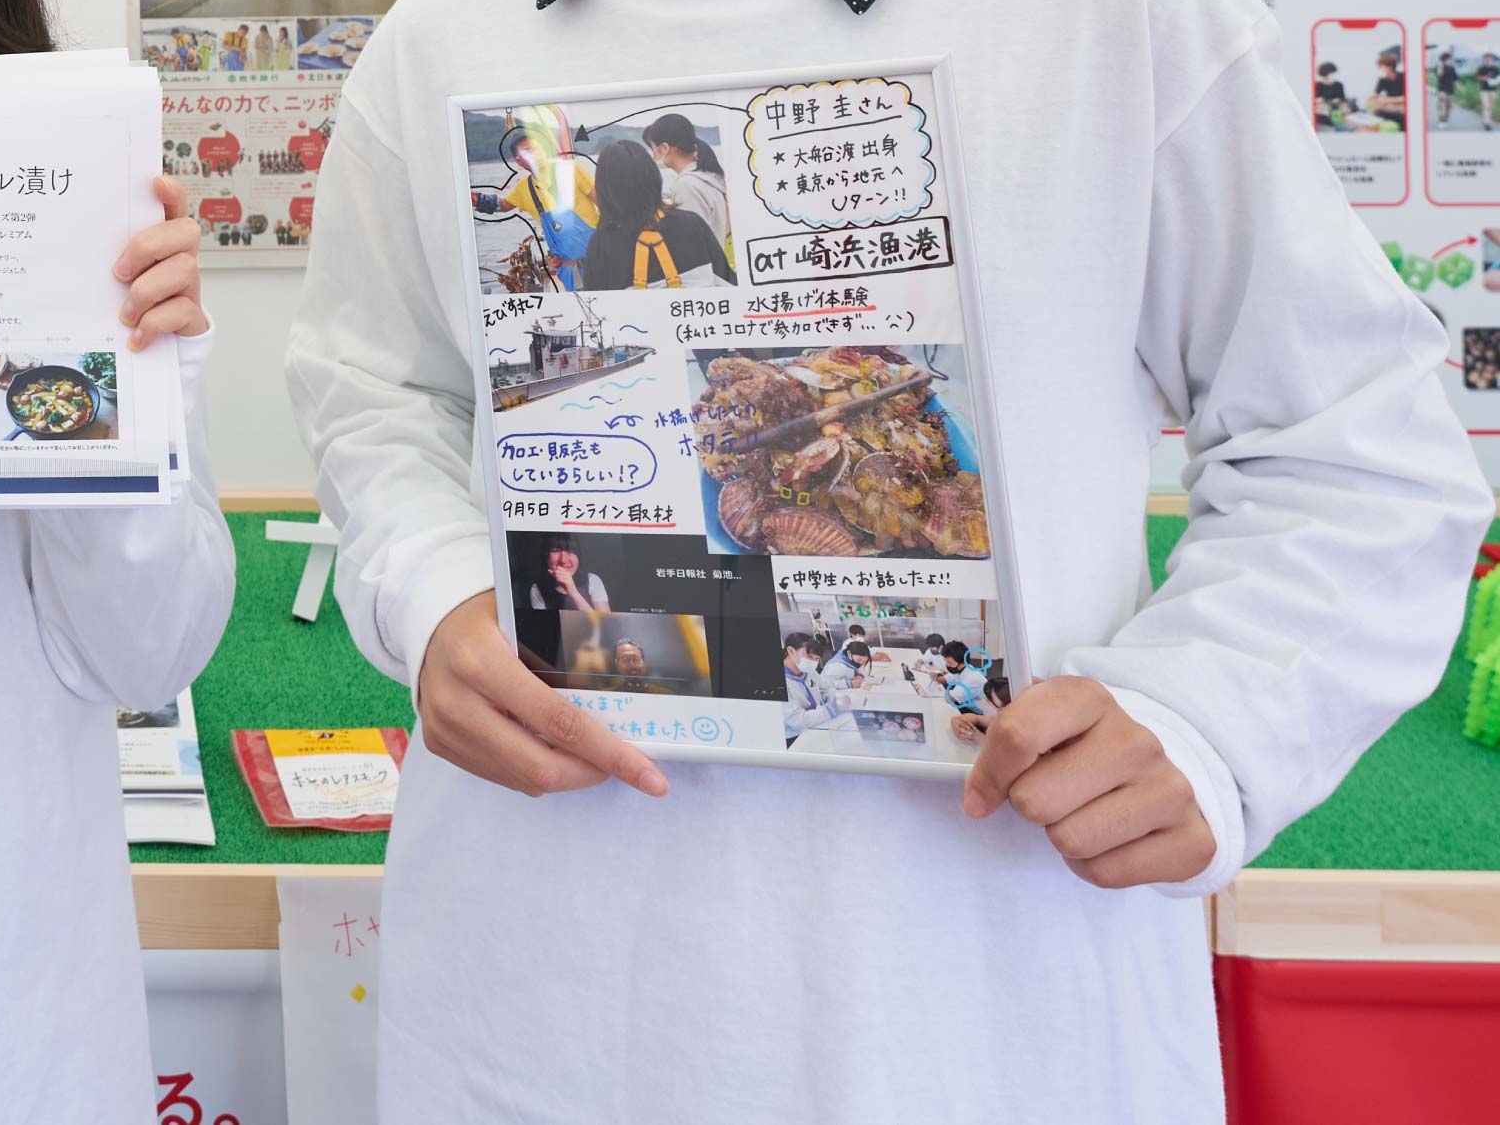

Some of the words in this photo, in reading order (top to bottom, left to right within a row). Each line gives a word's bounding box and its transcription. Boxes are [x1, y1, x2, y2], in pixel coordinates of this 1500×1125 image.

[162, 93, 344, 114] みんなの力で、ニッポ
[765, 97, 821, 131] 中野
[832, 93, 894, 121] 圭さん
[793, 133, 899, 169] 大船渡出身
[796, 166, 904, 196] 東京から地元へ
[754, 247, 788, 273] at
[795, 226, 942, 271] 崎浜漁港
[669, 298, 730, 319] 8月30日
[745, 286, 870, 315] 水揚げ体験
[654, 403, 757, 428] 水揚げしたての
[502, 500, 550, 519] 9月5日
[560, 499, 674, 523] オンライン取材
[656, 568, 707, 579] 岩手日報社
